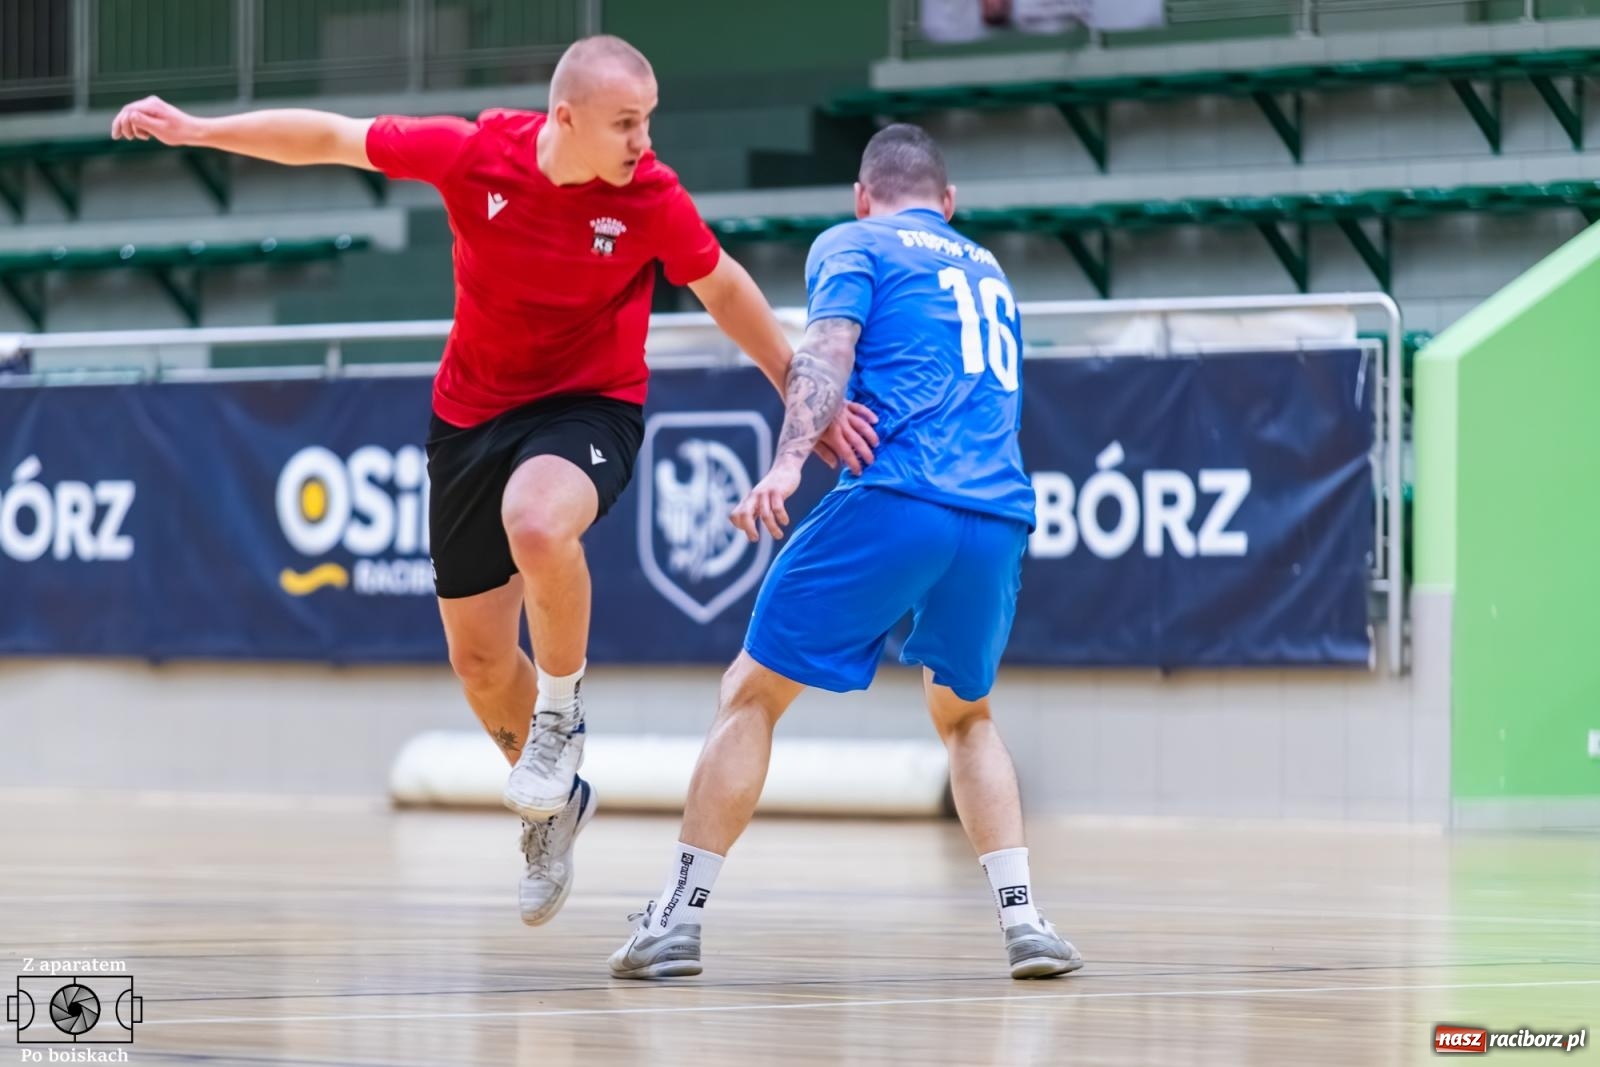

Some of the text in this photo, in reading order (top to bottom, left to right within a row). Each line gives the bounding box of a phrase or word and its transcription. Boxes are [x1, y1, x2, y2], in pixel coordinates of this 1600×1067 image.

[938, 266, 1019, 392] 16
[1030, 440, 1252, 559] BÓRZ
[1000, 886, 1027, 908] FS
